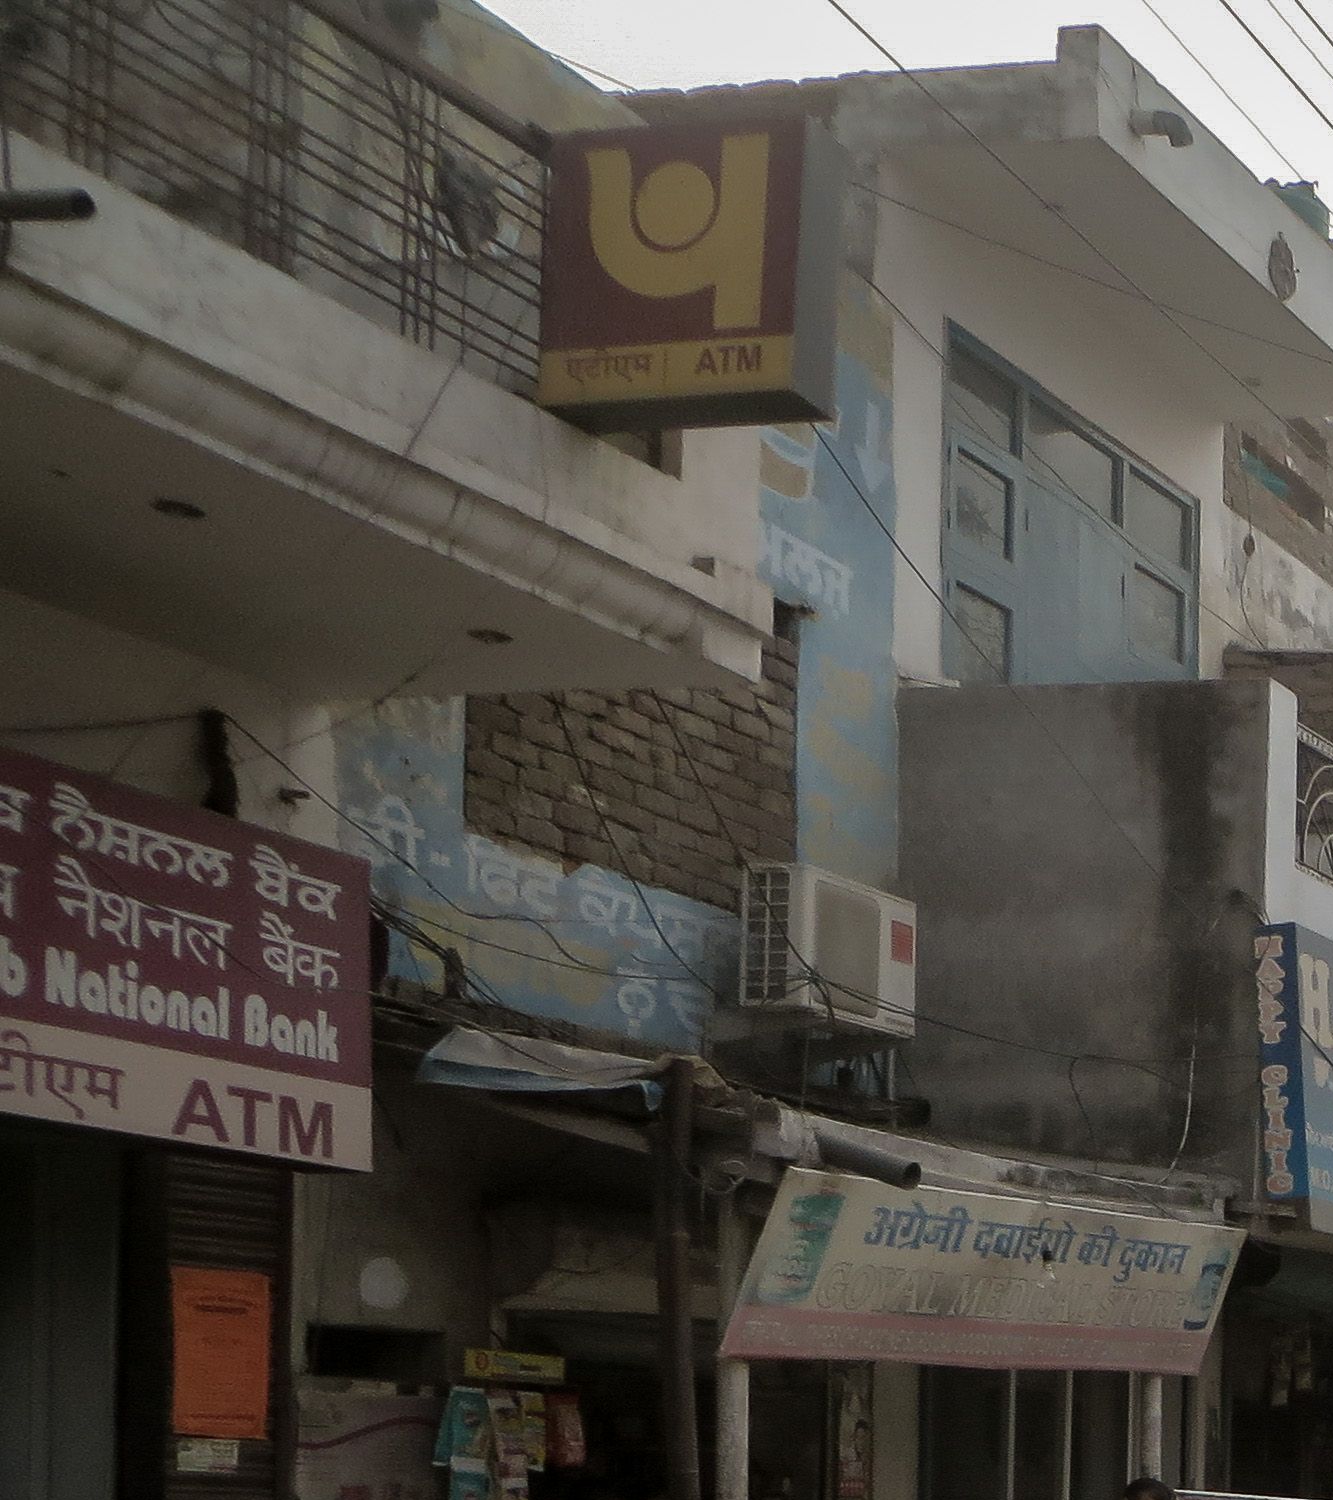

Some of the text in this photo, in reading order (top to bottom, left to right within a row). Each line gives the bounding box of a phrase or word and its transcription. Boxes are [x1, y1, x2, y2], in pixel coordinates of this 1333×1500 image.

[694, 345, 763, 376] ATM
[54, 854, 233, 971] नैशनल
[45, 947, 230, 1040] National
[244, 994, 338, 1063] Bank
[172, 1079, 334, 1158] ATM
[1113, 1238, 1192, 1283] दुकान
